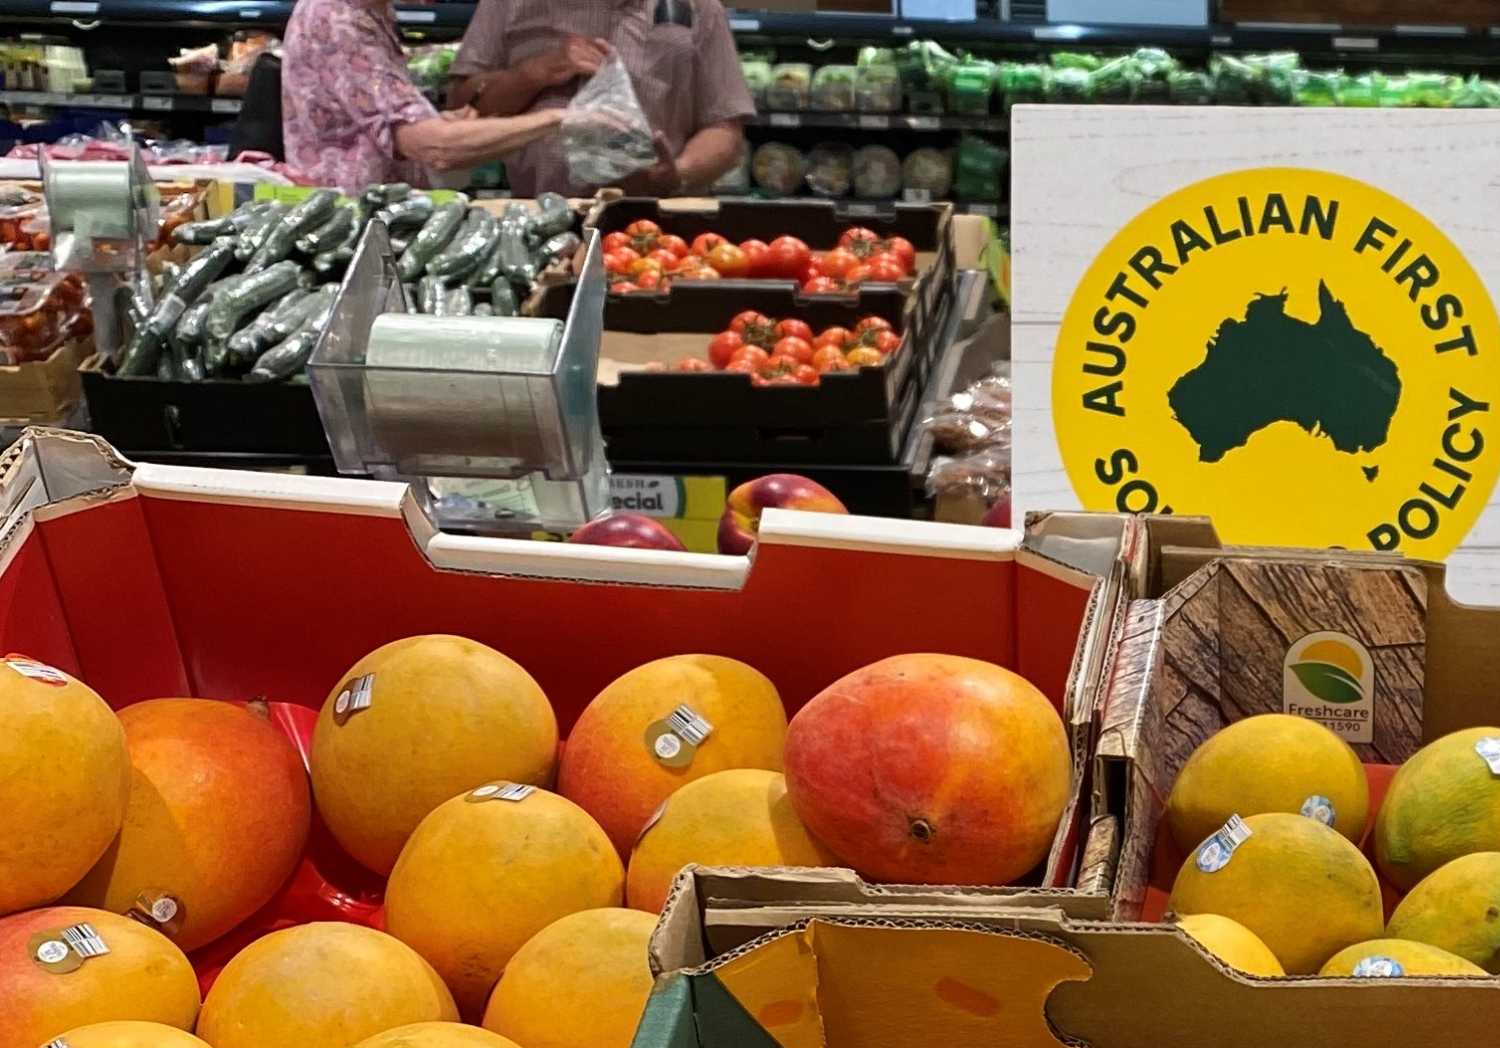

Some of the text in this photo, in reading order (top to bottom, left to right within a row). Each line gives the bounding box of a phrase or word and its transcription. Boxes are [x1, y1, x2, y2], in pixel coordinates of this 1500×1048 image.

[1081, 193, 1478, 418] AUSTRALIAN FIRST
[1366, 387, 1491, 551] POLICY
[1288, 703, 1369, 718] Freshcare
